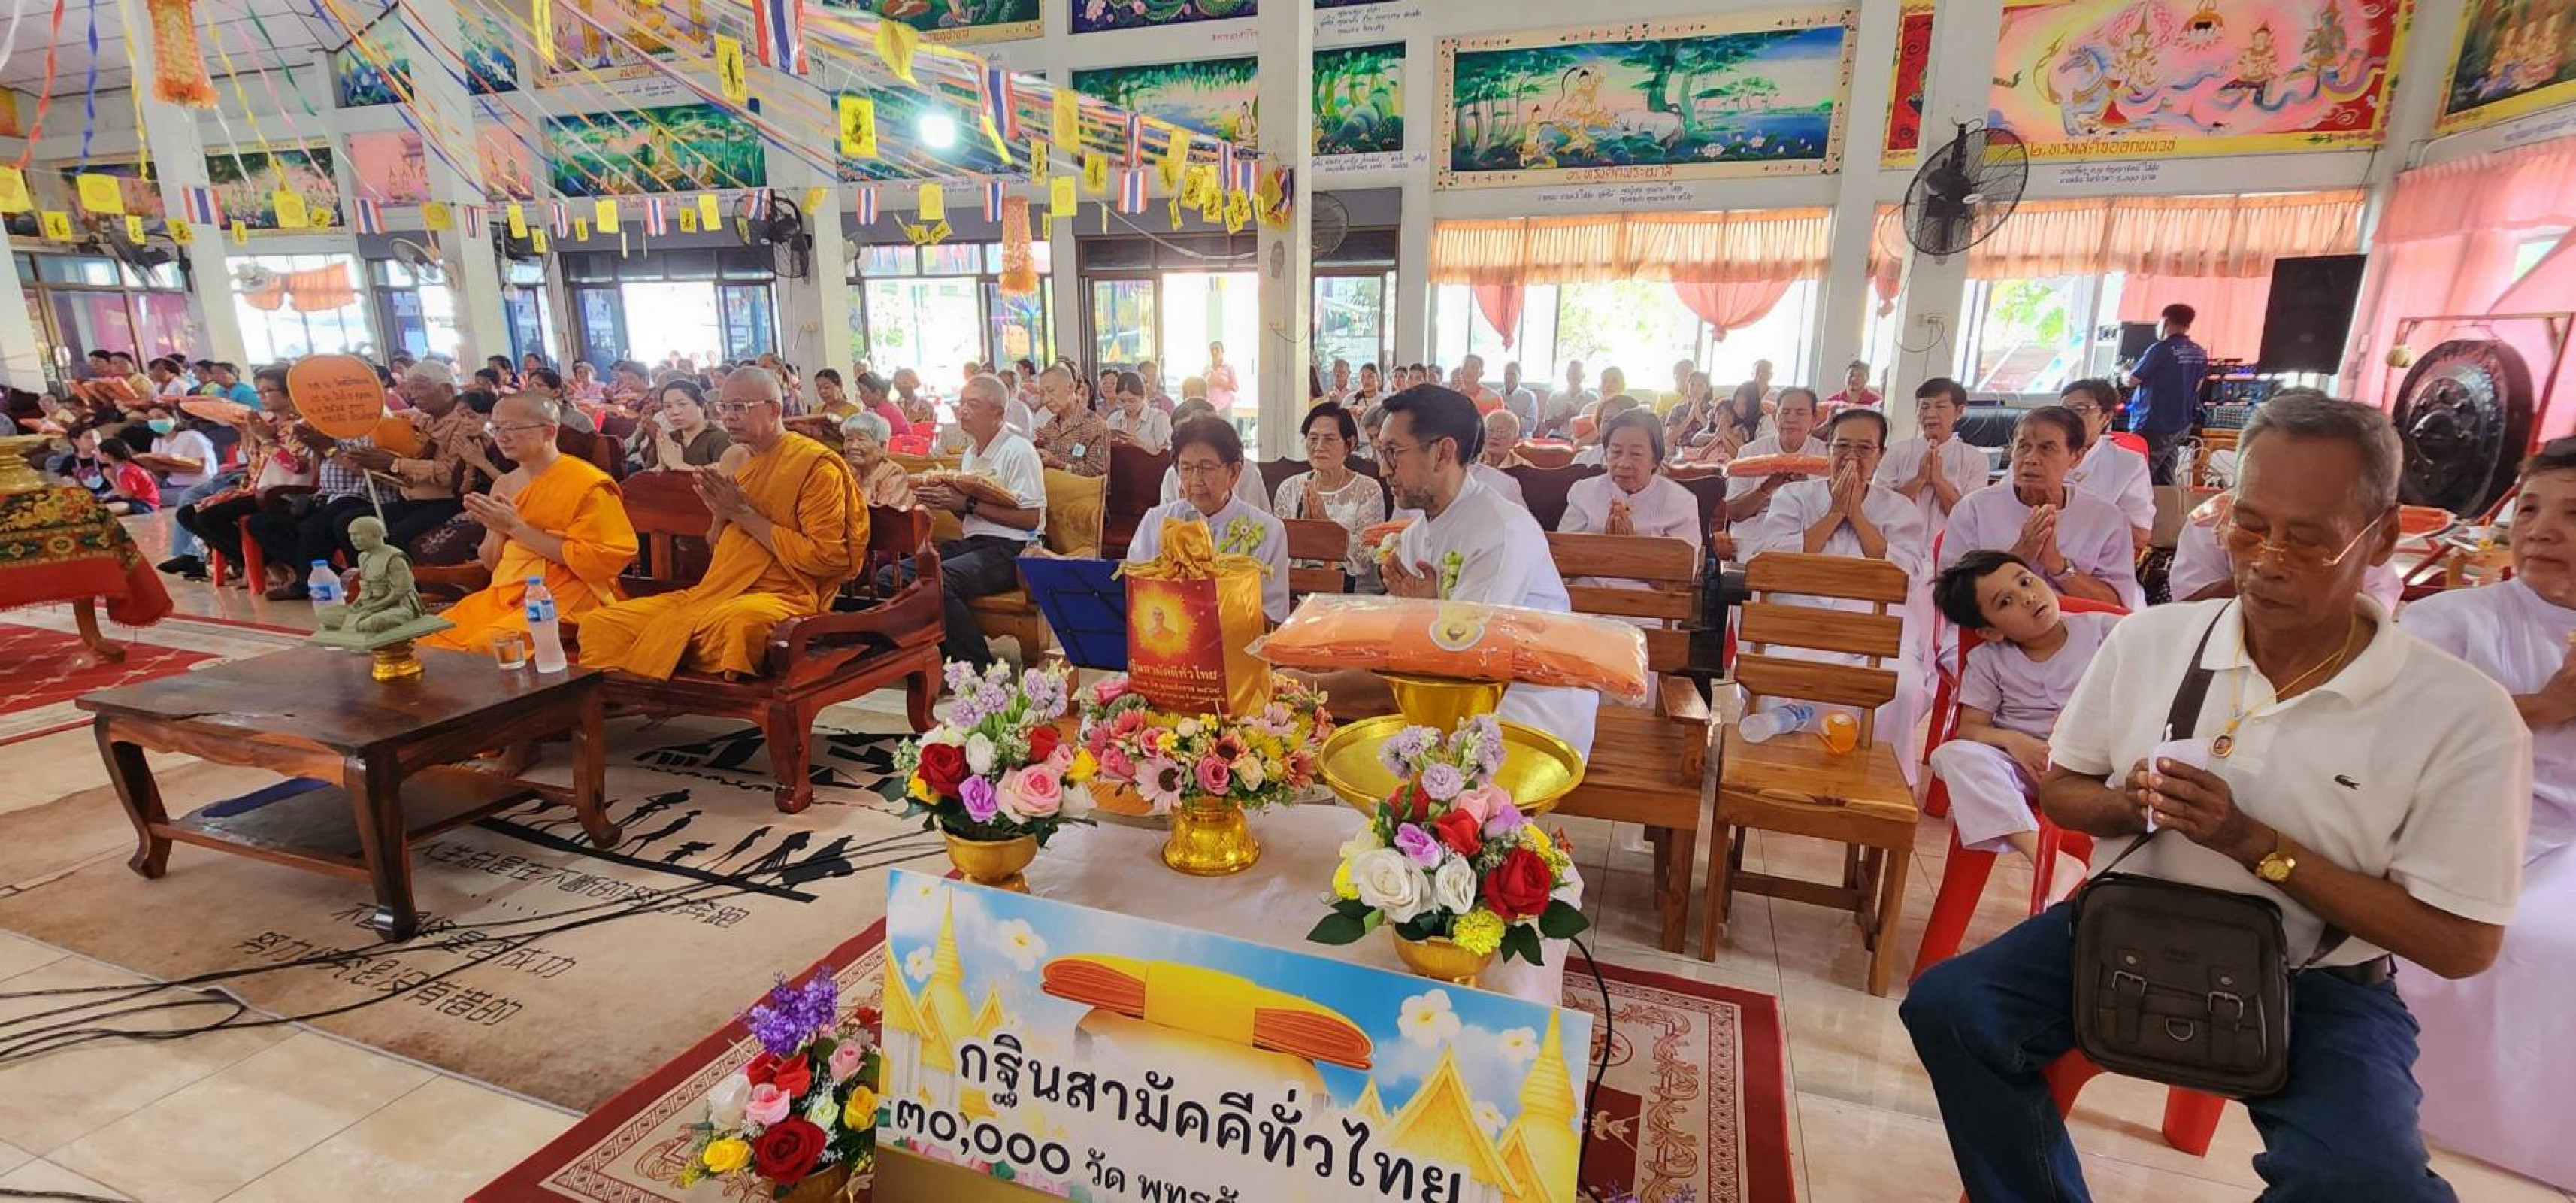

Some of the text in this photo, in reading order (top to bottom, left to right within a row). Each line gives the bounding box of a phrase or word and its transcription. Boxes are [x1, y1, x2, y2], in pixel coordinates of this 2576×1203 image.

[897, 1098, 1070, 1175] ๓๐,๐๐๐
[1085, 1147, 1126, 1193] วัด
[958, 1032, 1461, 1203] กฐินสามัคคีทั่วไทย
